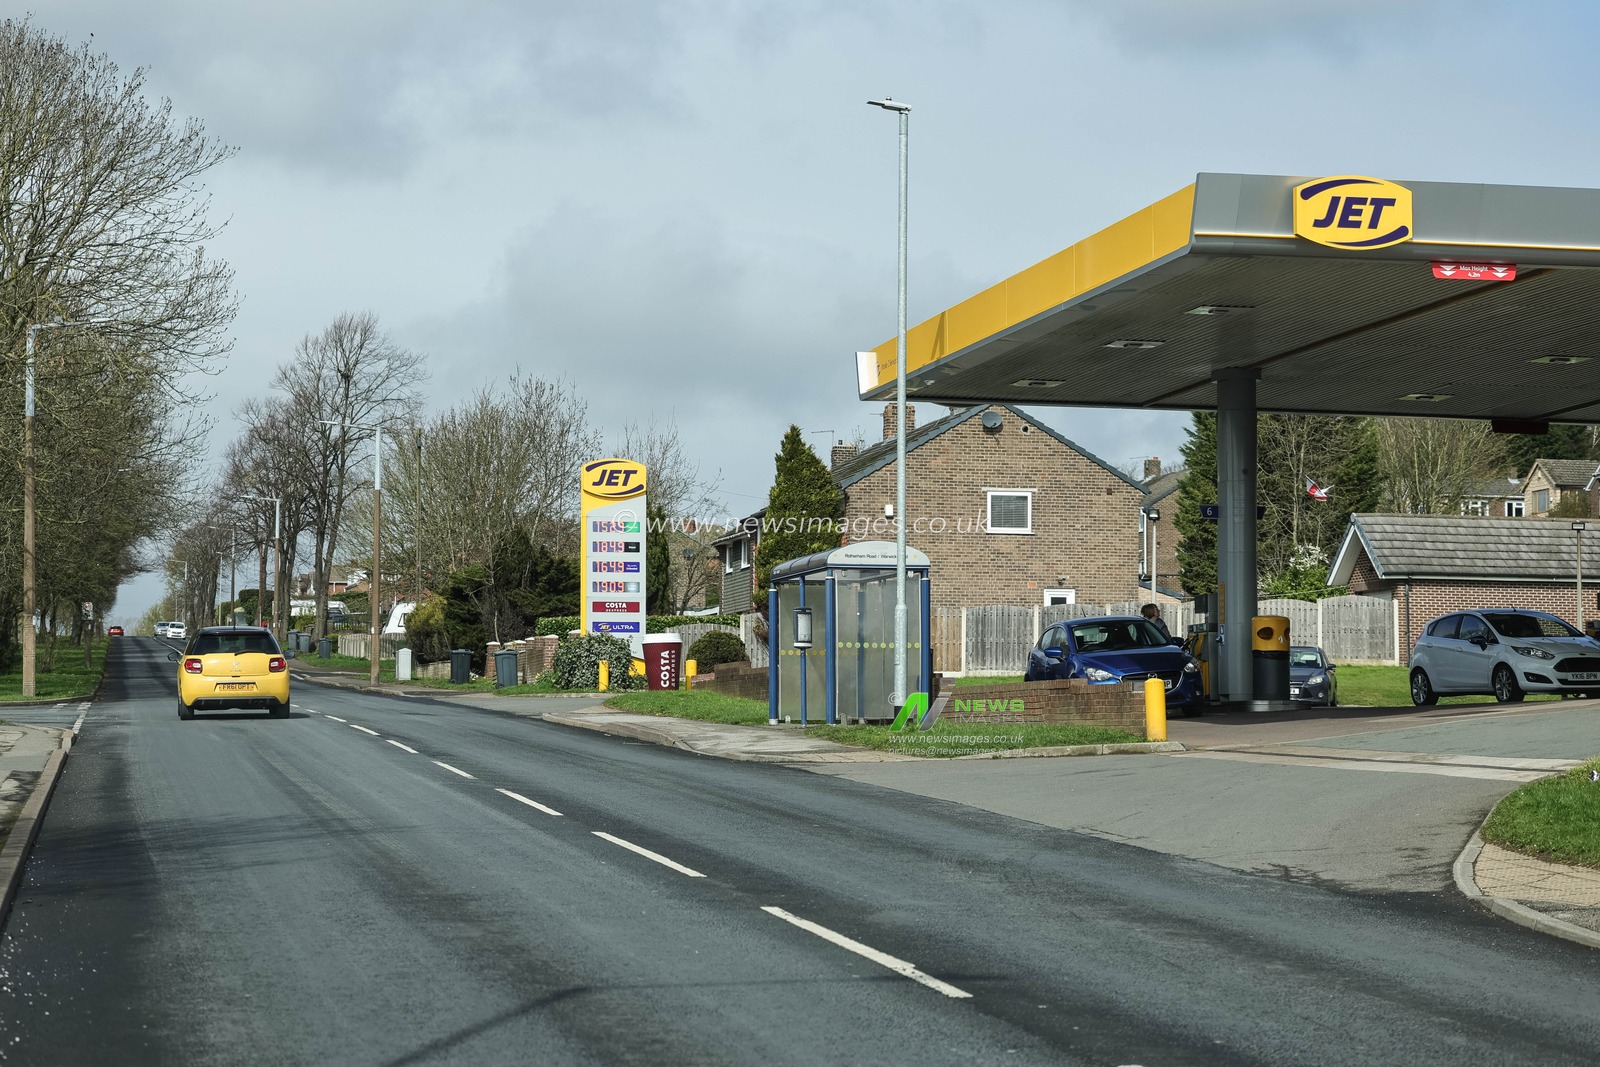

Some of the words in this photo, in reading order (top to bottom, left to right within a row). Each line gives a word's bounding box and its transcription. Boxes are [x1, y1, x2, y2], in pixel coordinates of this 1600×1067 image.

[1312, 195, 1397, 230] JET
[592, 469, 638, 486] JET
[1206, 506, 1213, 516] 6
[660, 650, 671, 688] COSTA
